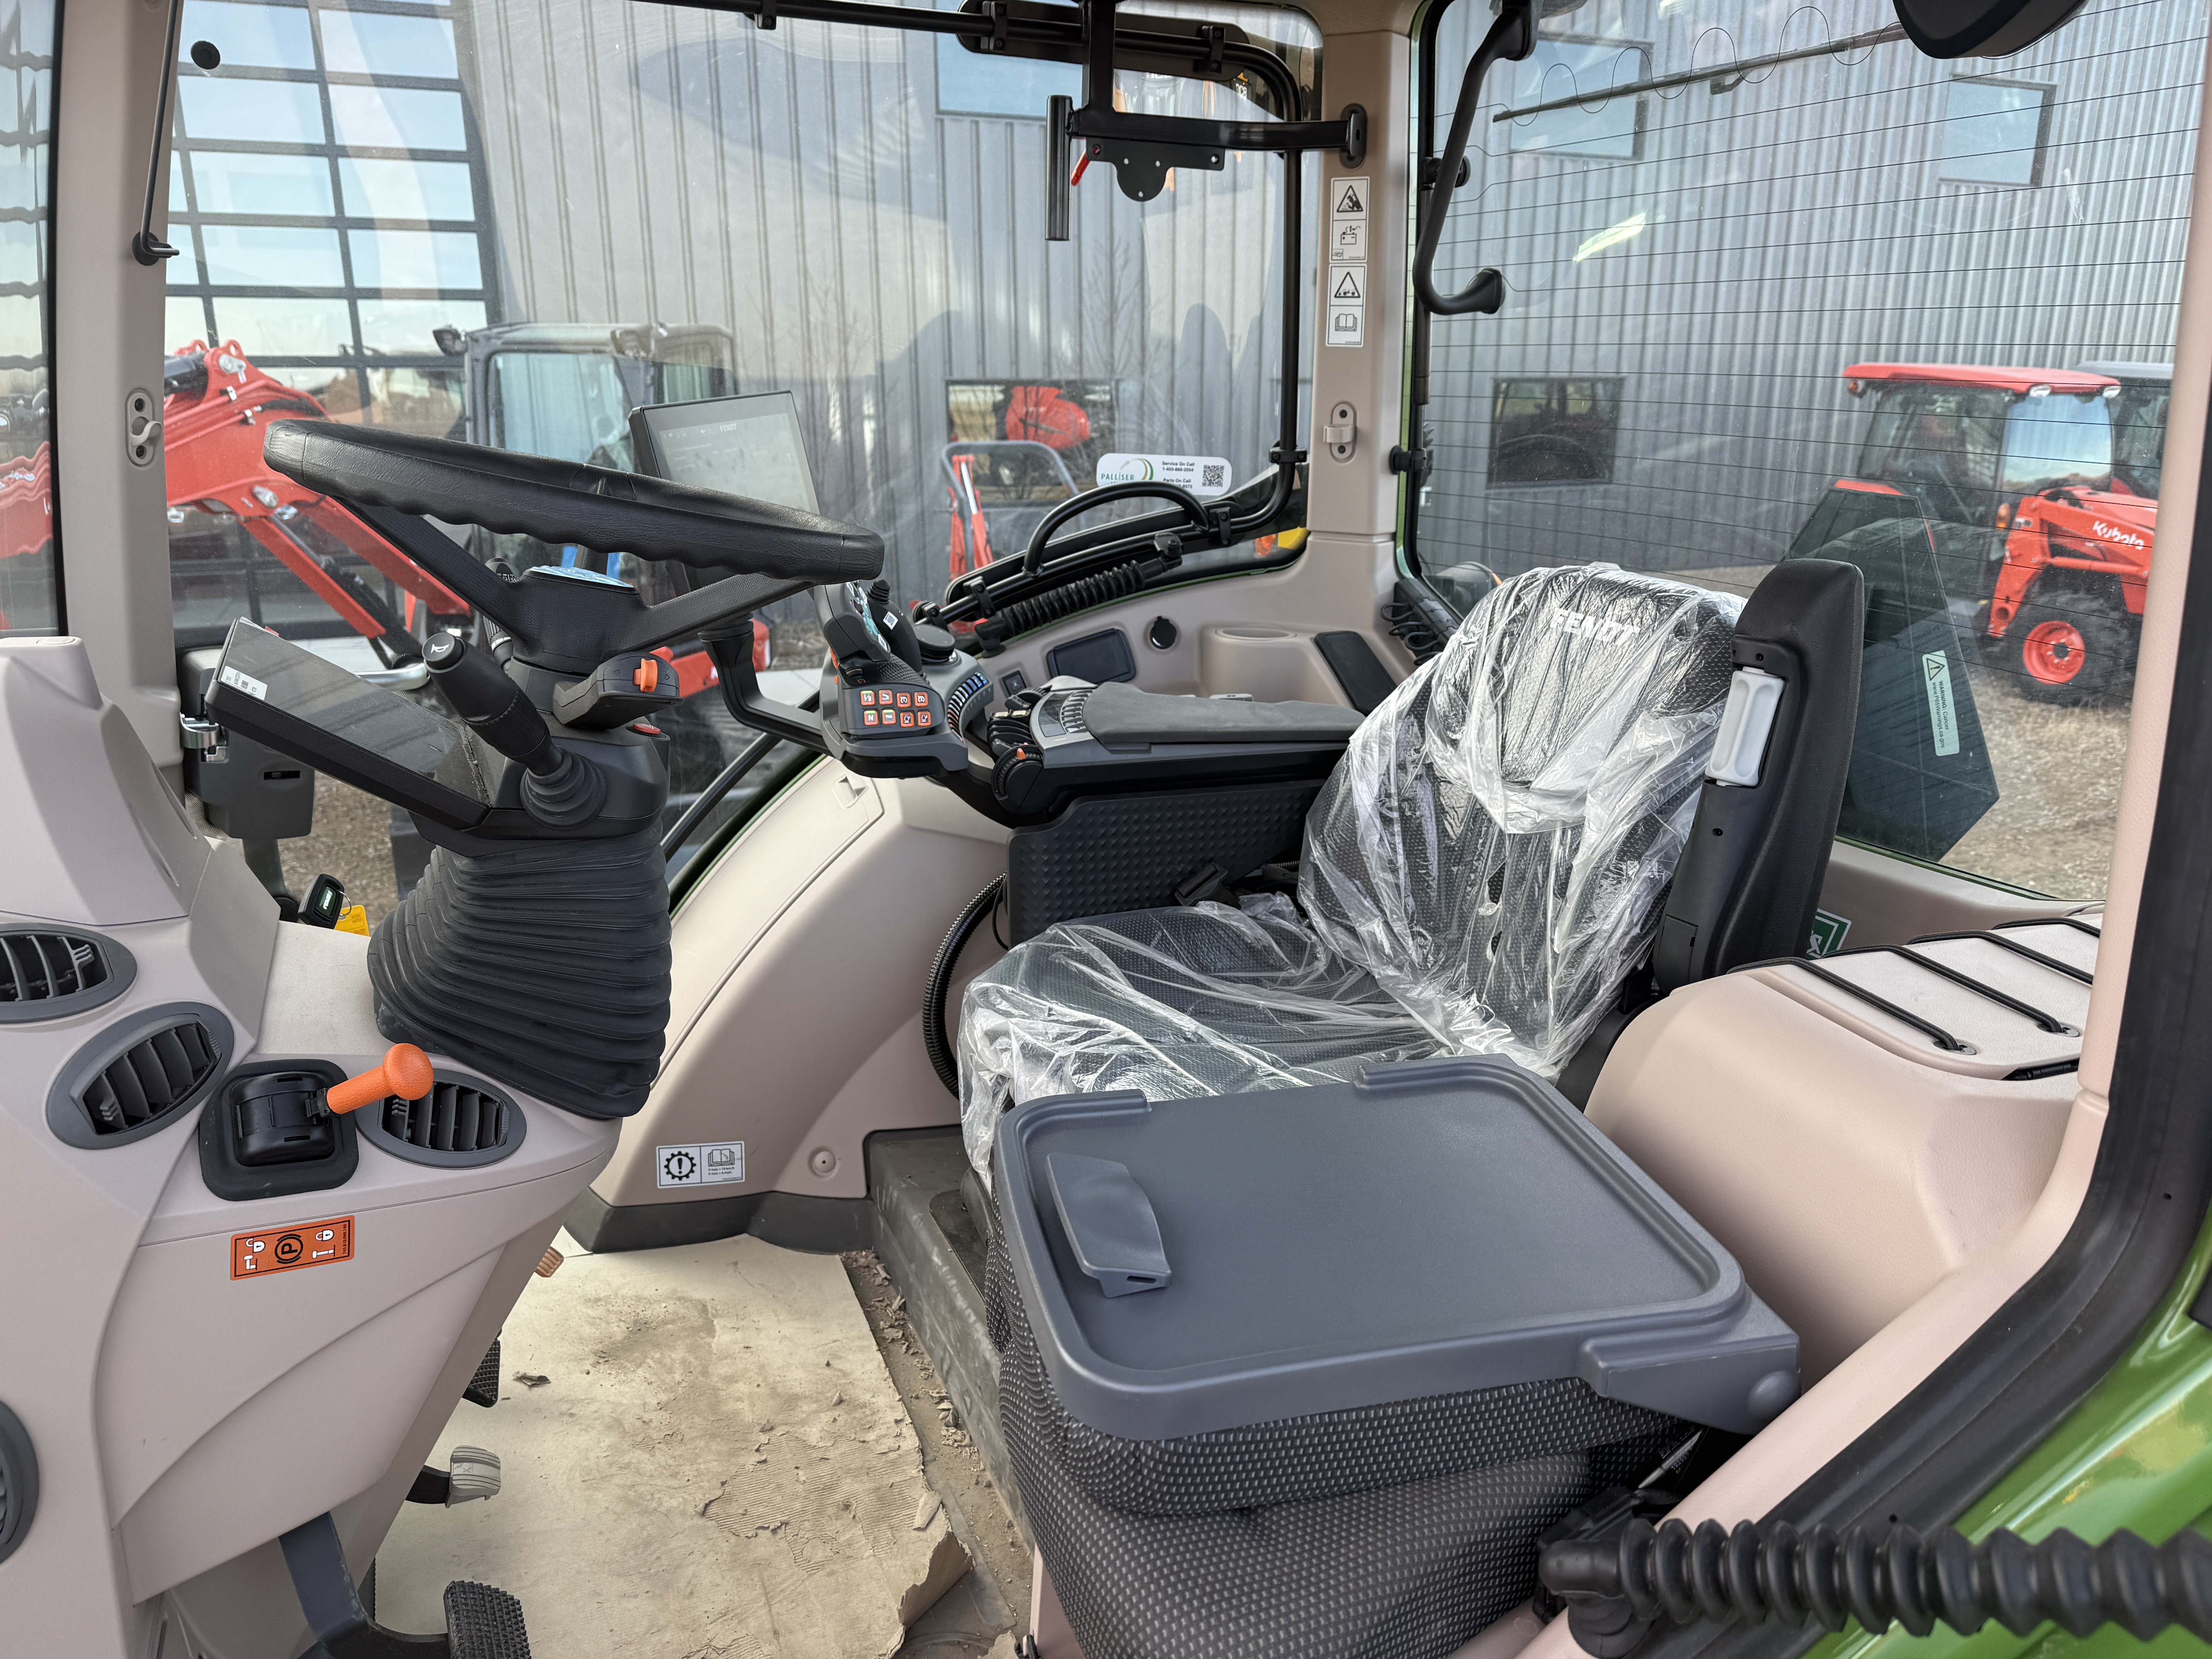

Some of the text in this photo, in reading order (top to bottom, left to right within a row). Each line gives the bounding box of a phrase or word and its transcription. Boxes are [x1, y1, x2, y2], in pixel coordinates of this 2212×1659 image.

[1101, 472, 1134, 480] PALLISER
[2093, 520, 2145, 550] Kubota
[1939, 680, 1947, 710] WARNING:
